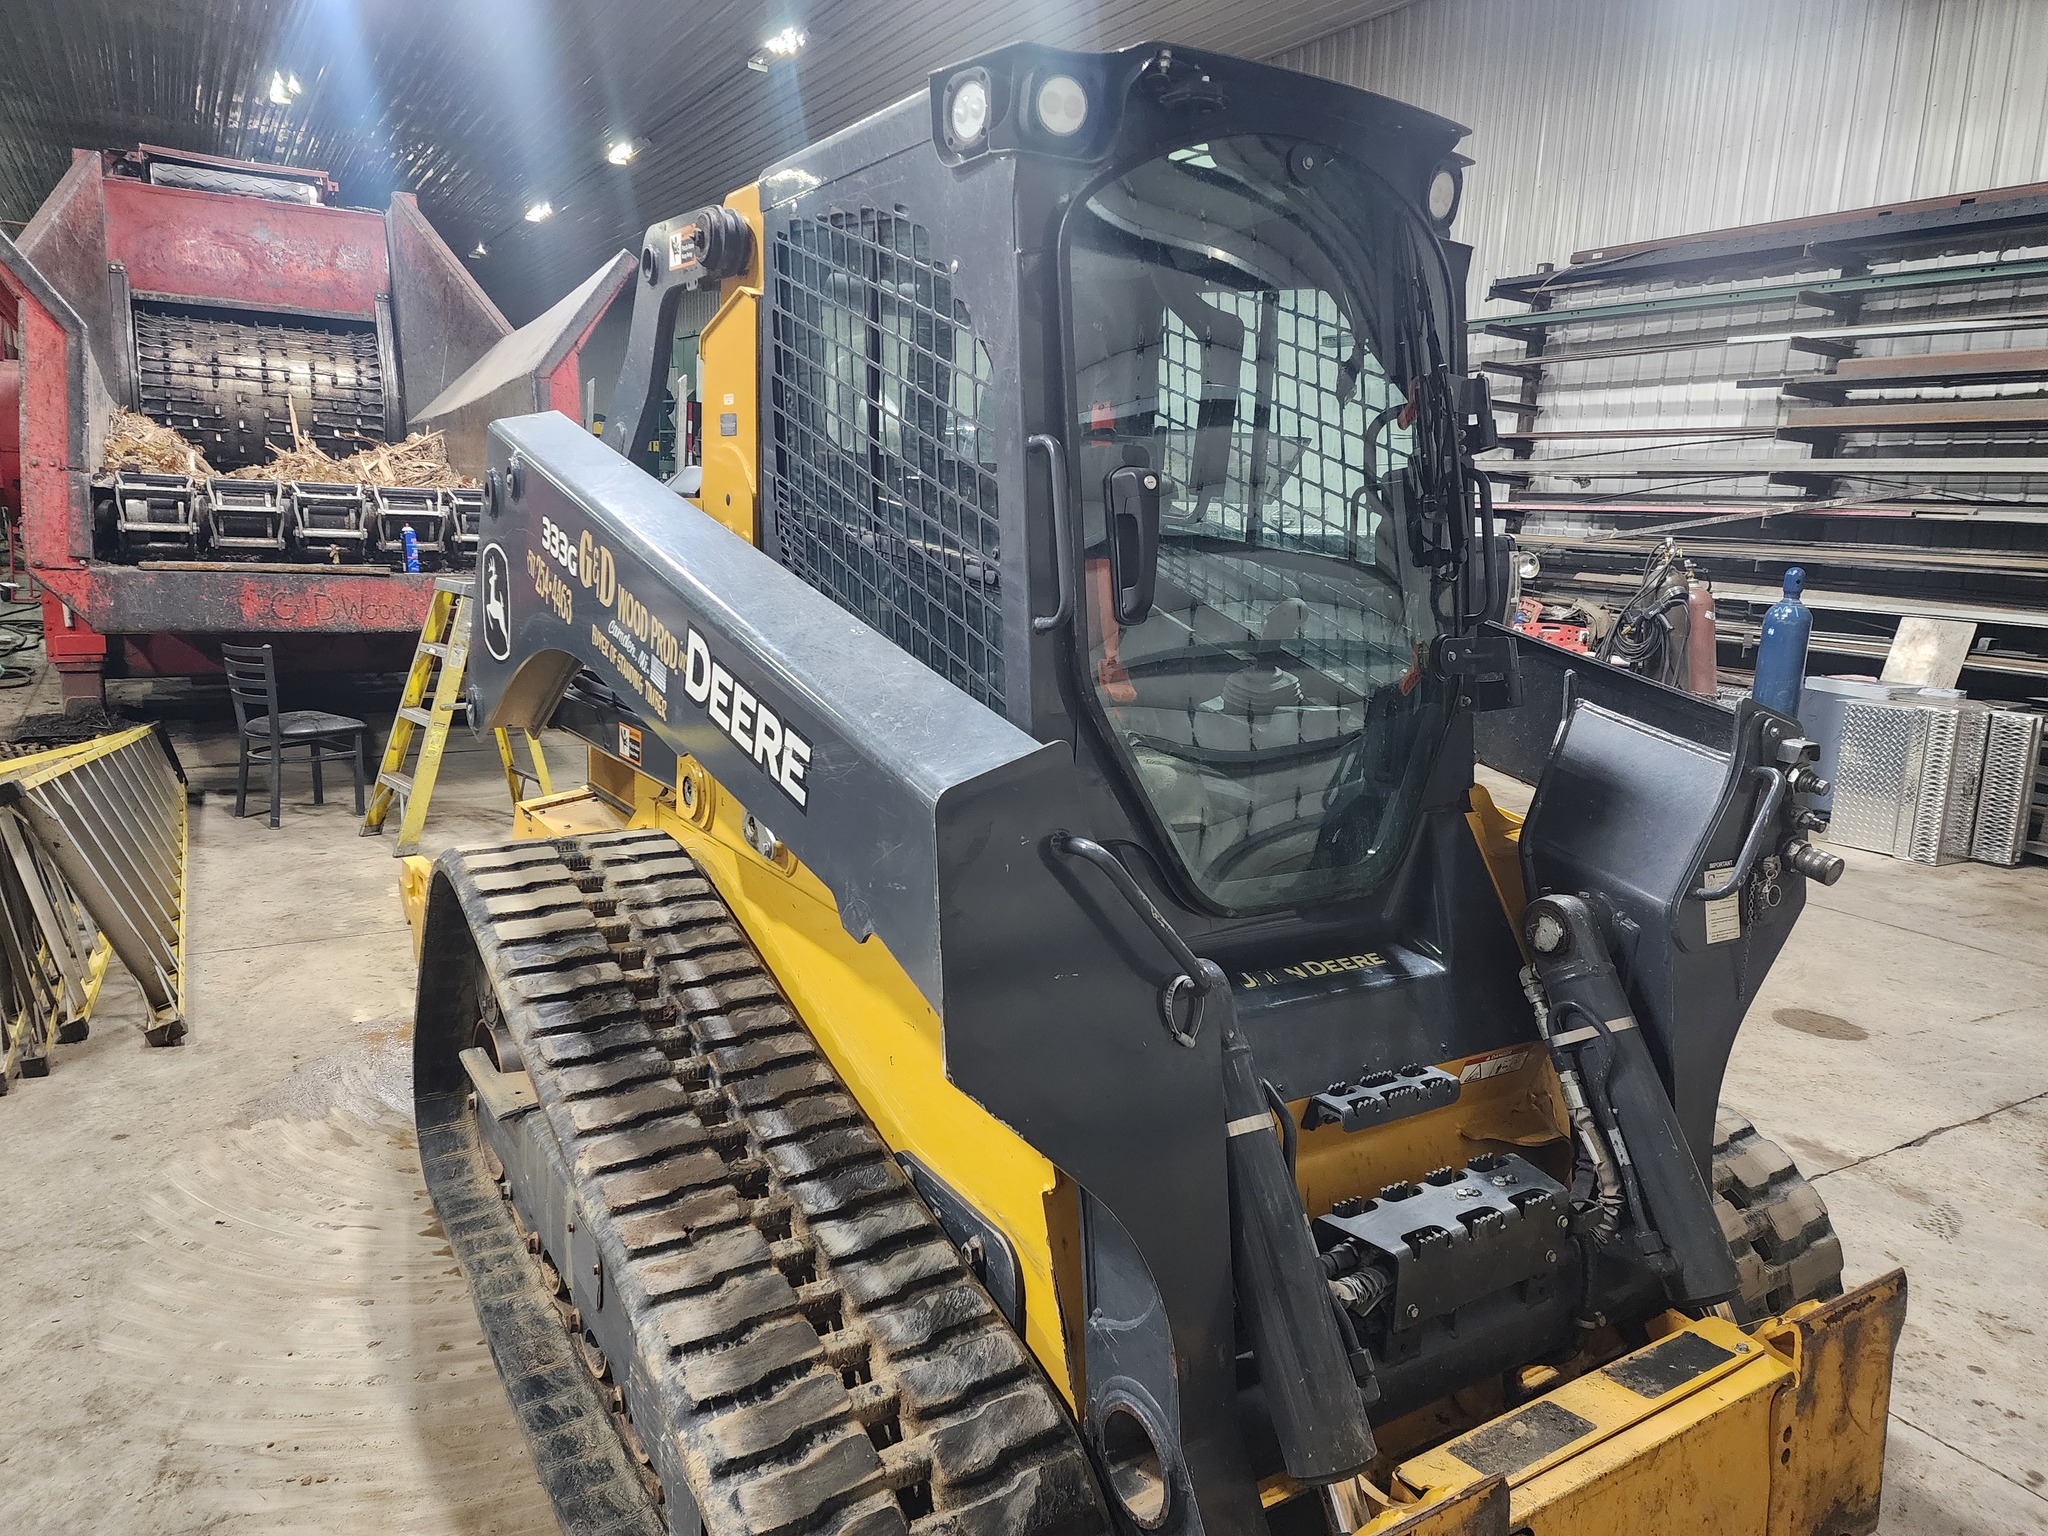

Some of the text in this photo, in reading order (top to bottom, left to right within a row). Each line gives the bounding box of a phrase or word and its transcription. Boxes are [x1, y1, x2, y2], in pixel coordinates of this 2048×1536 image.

[541, 515, 578, 577] 333G
[579, 529, 616, 608] G&D
[617, 583, 649, 643] WOOD
[650, 614, 679, 676] PROD.
[644, 679, 668, 722] TIMBER
[685, 628, 812, 807] DEERE
[1708, 859, 1734, 870] IMPORTANT
[1302, 952, 1387, 977] DEERE
